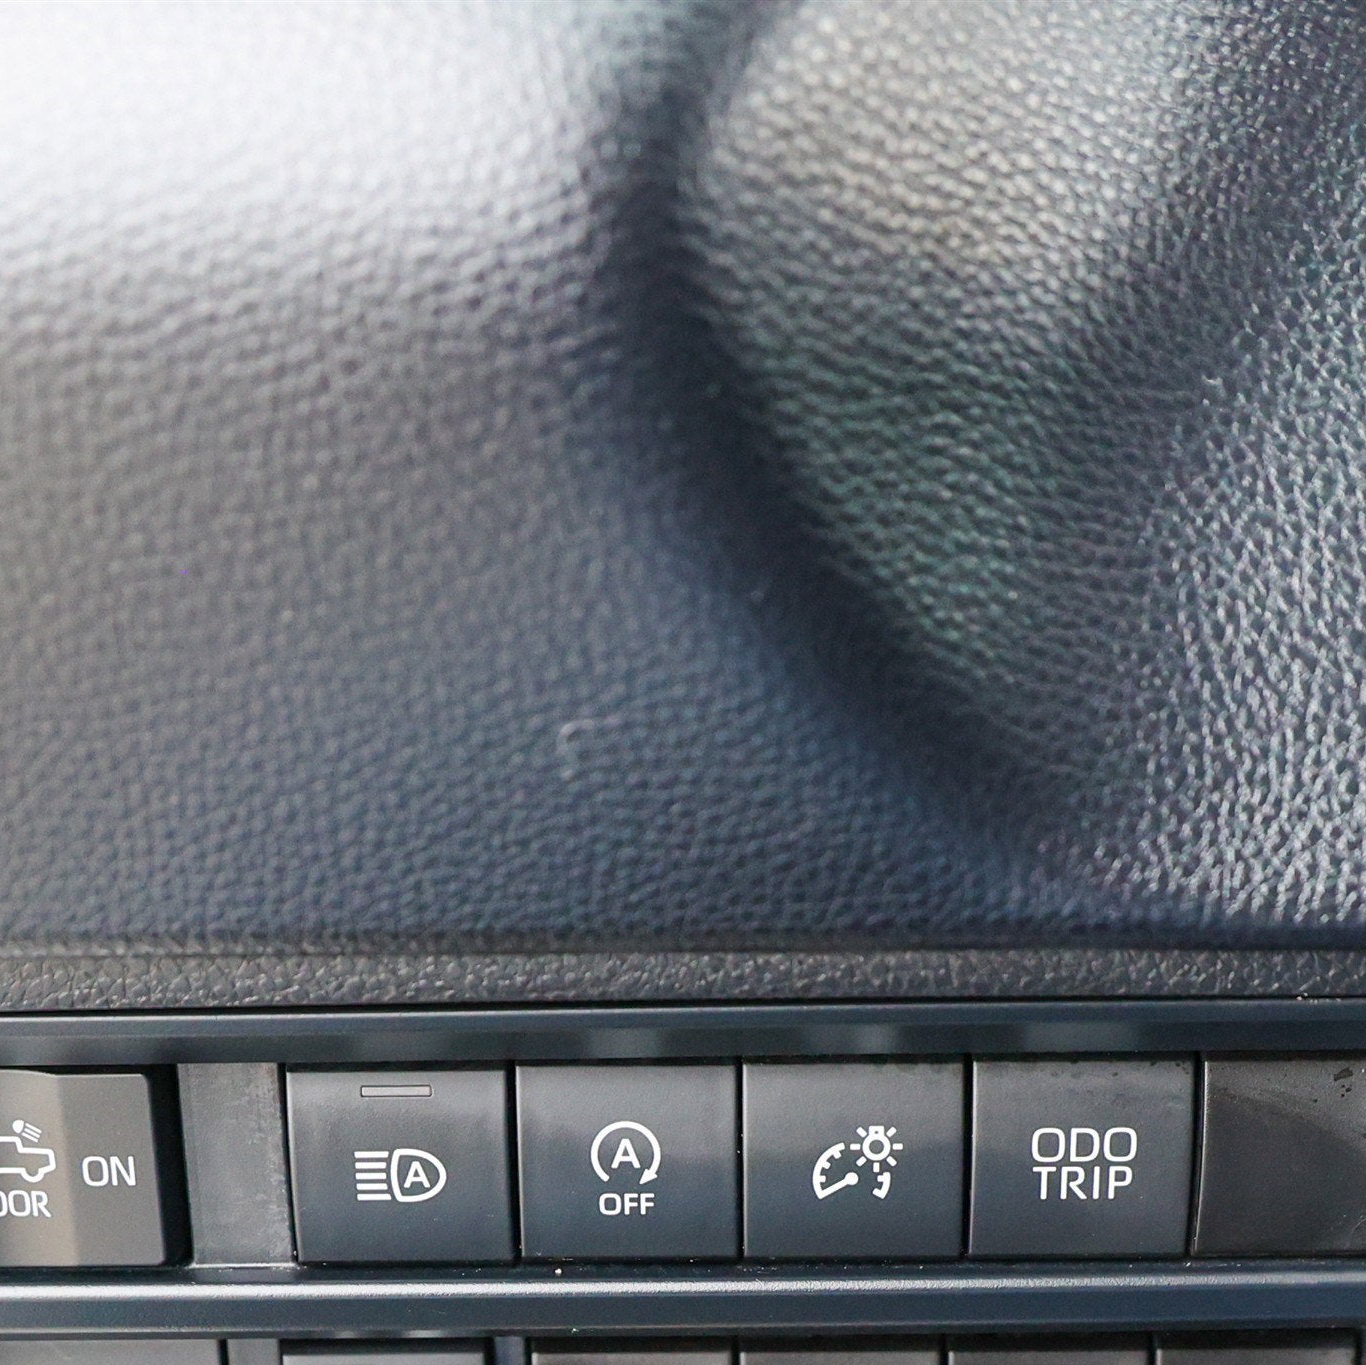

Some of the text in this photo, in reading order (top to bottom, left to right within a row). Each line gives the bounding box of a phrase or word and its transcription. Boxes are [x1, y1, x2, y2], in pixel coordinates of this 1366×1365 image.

[611, 1138, 641, 1169] A
[1031, 1126, 1137, 1163] ODO
[81, 1156, 137, 1187] ON
[1032, 1165, 1133, 1200] TRIP
[598, 1192, 655, 1216] OFF
